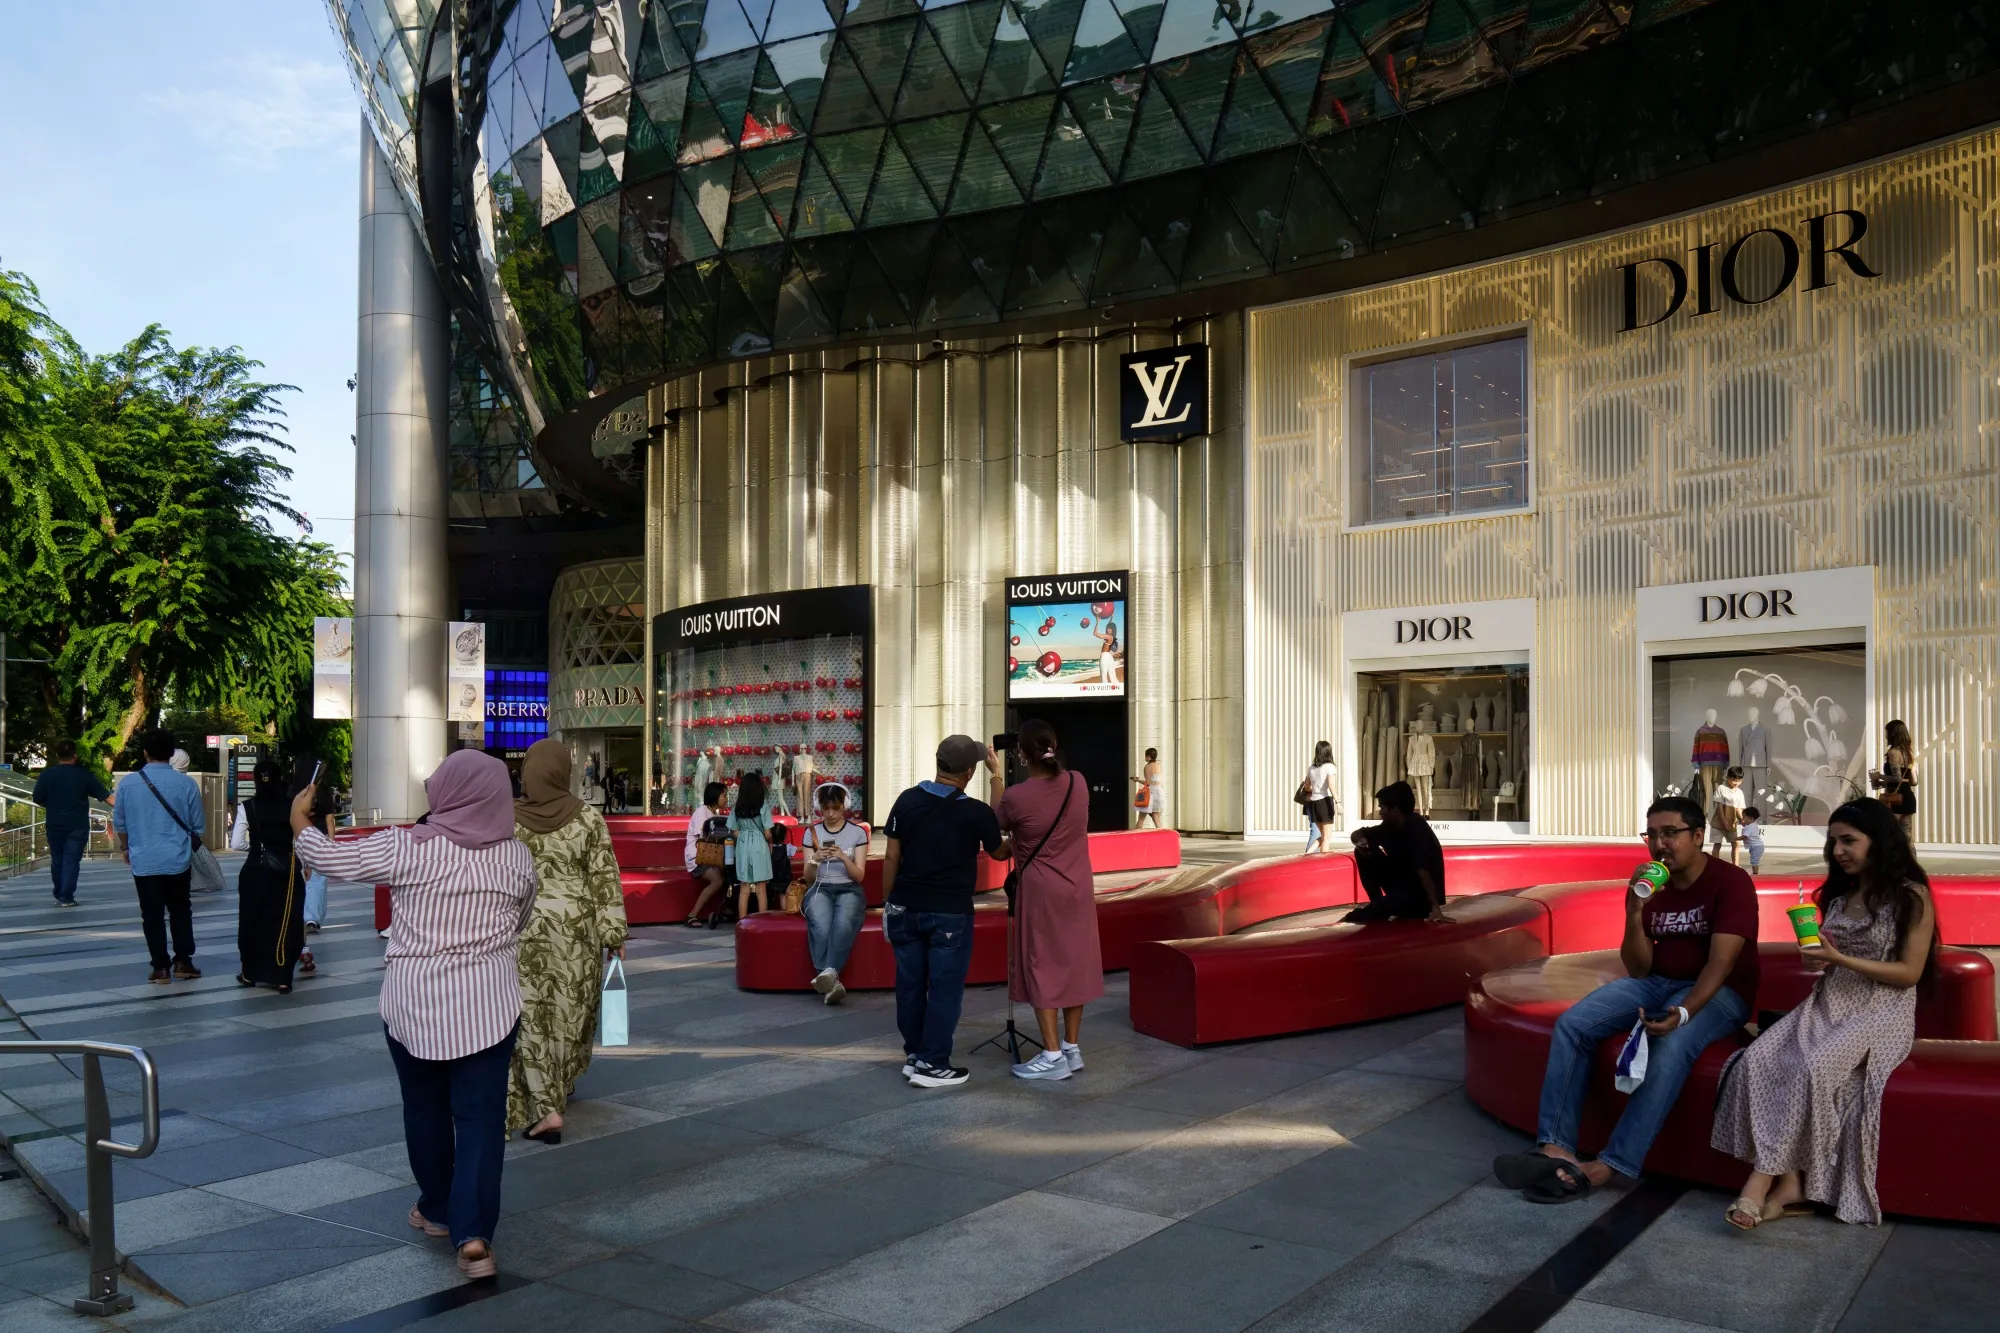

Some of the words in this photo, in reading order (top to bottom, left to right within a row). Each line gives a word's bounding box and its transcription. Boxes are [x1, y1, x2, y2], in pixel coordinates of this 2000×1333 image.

[1615, 209, 1882, 333] DIOR
[1011, 583, 1053, 598] LOUIS
[1056, 578, 1121, 596] VUITTON
[1698, 589, 1797, 622] DIOR
[681, 613, 712, 637] LOUIS
[714, 604, 780, 632] VUITTON
[1395, 616, 1475, 643] DIOR
[575, 686, 645, 708] PRADA
[486, 702, 550, 720] RBERRY
[1651, 905, 1705, 926] HEART
